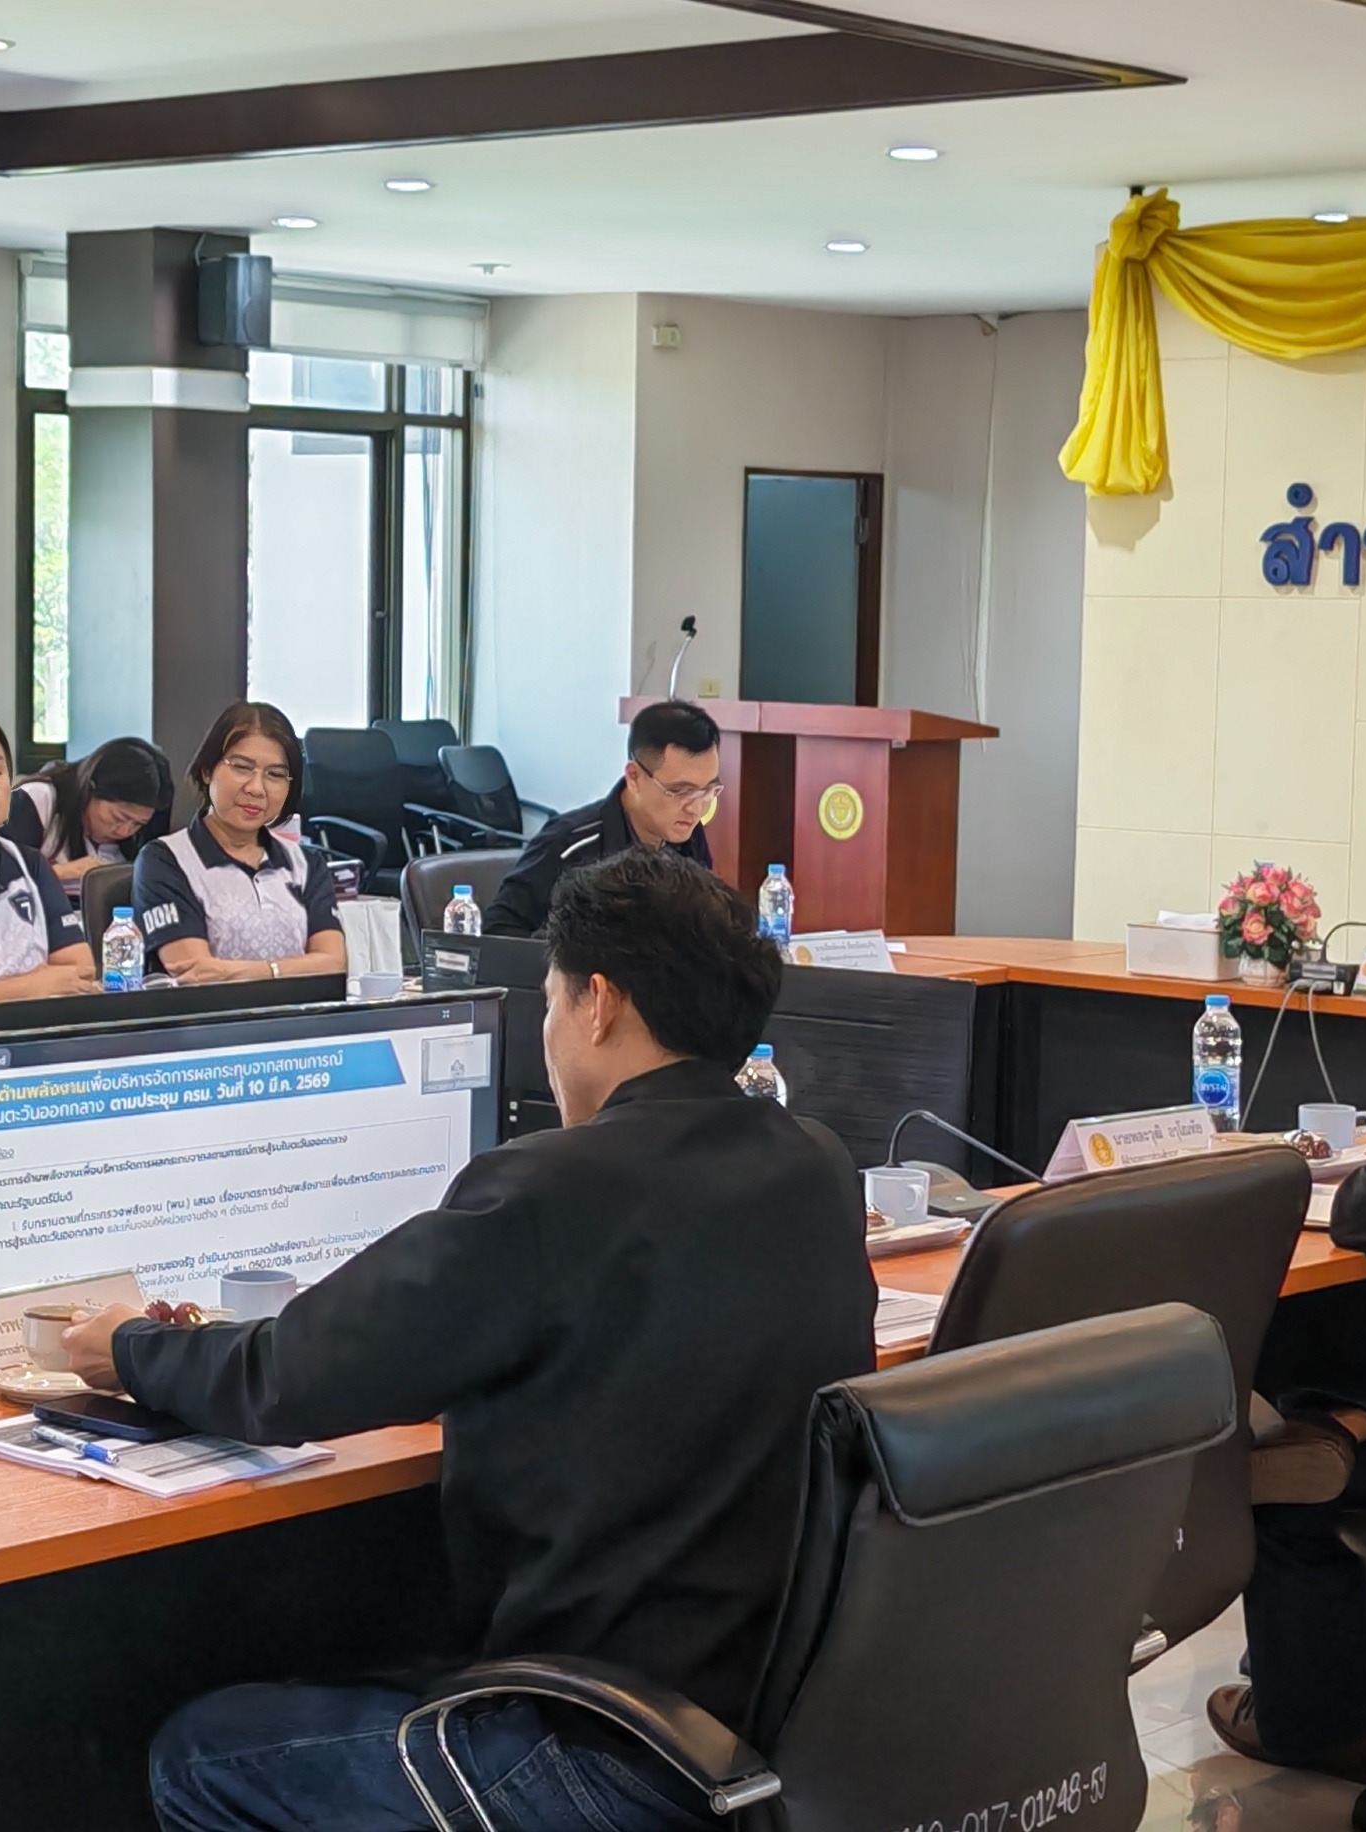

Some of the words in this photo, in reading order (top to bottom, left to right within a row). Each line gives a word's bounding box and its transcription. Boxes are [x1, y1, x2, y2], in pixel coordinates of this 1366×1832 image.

[20, 901, 33, 921] 7
[142, 902, 180, 935] DOH
[109, 1090, 180, 1112] ตามประชุม
[182, 1085, 214, 1104] ครม.
[216, 1075, 245, 1099] วันที่
[247, 1080, 265, 1096] 10
[268, 1076, 292, 1094] มี.ค.
[295, 1072, 331, 1090] 2569
